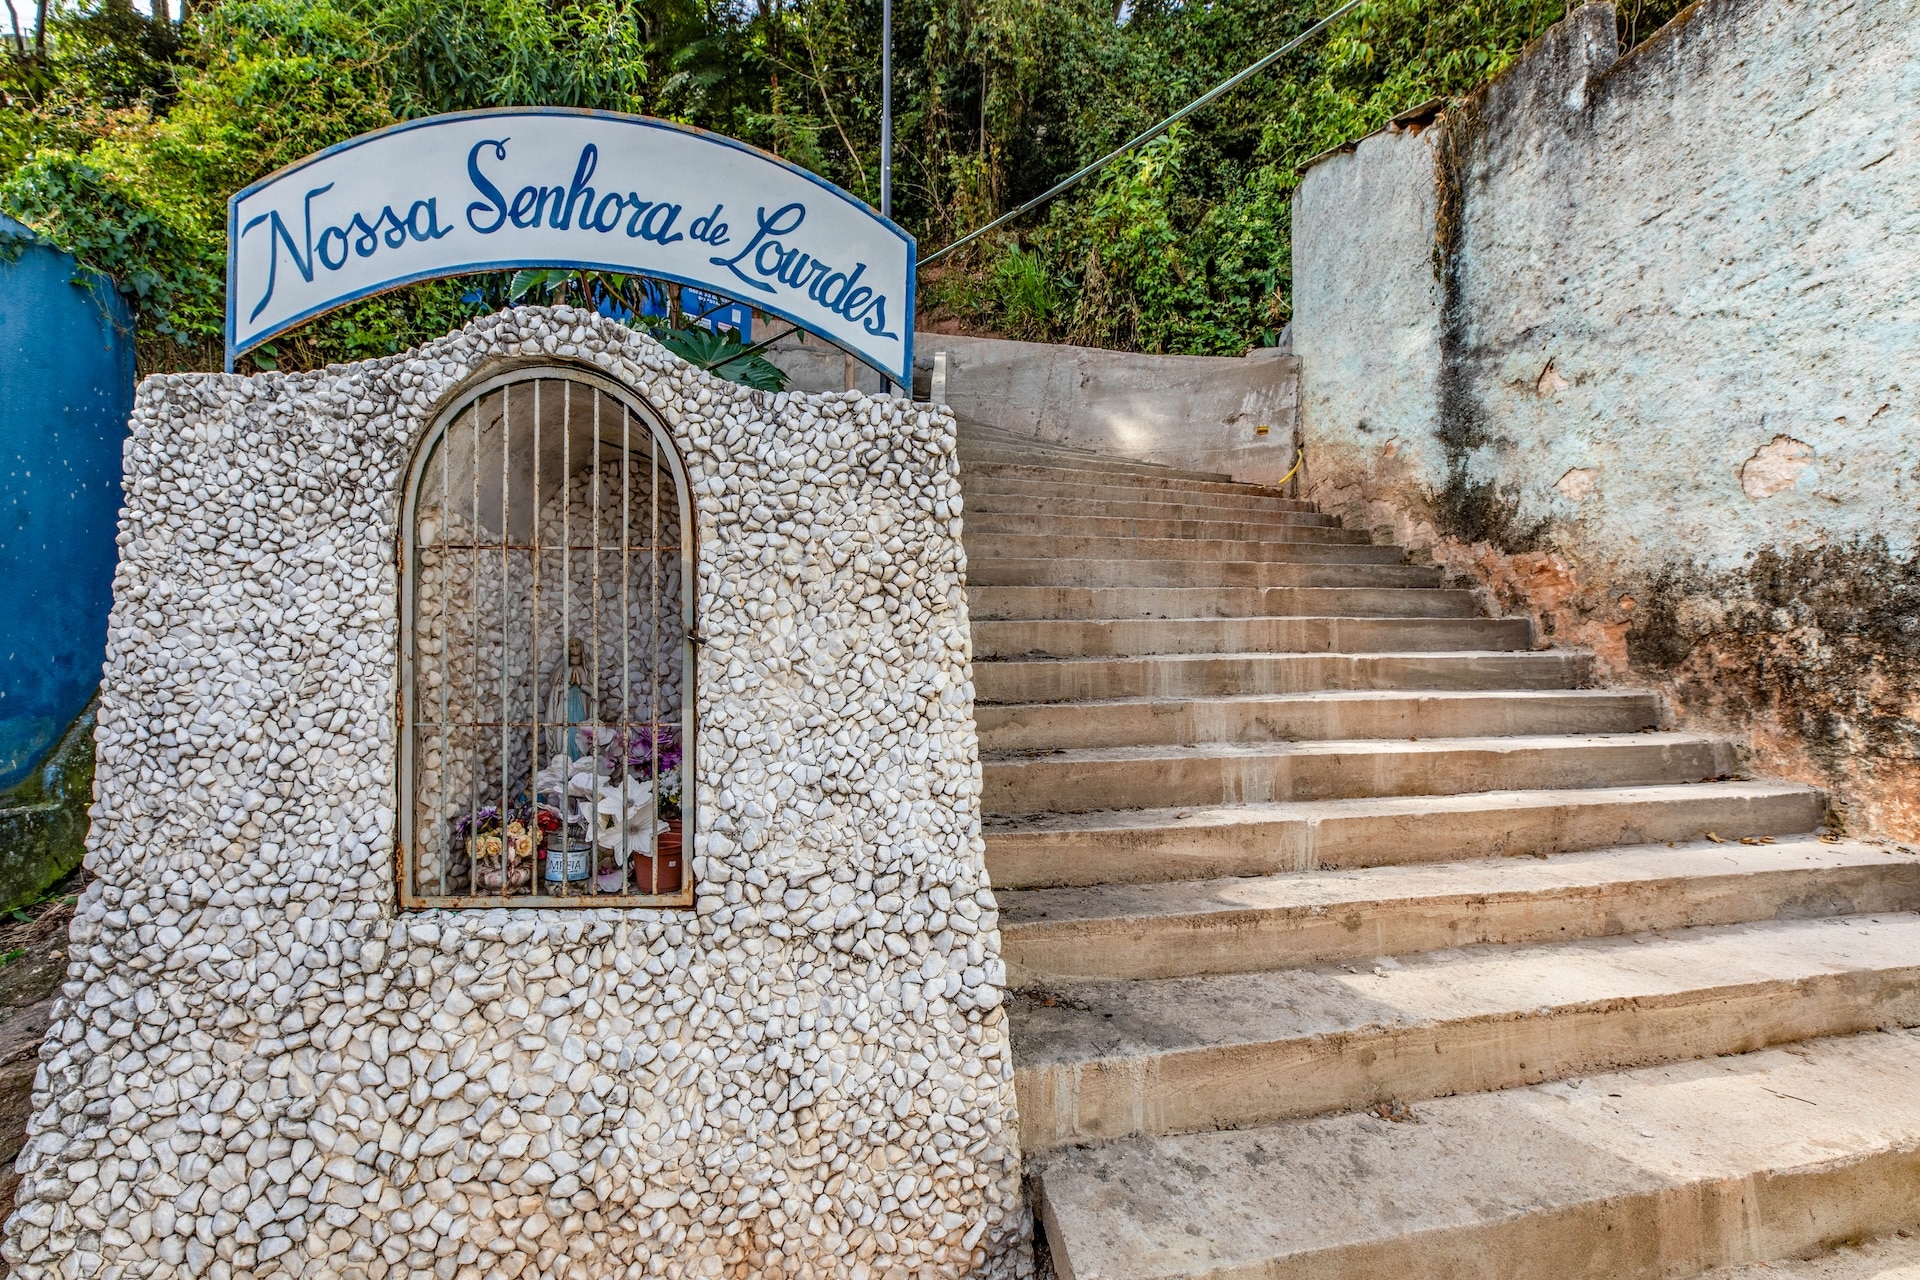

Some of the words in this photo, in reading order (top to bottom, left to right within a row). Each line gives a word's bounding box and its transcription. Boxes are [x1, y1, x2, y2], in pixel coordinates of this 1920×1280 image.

[242, 181, 455, 324] Nossa
[465, 137, 683, 246] Senhora
[689, 203, 731, 247] de
[708, 202, 899, 342] Lourdes
